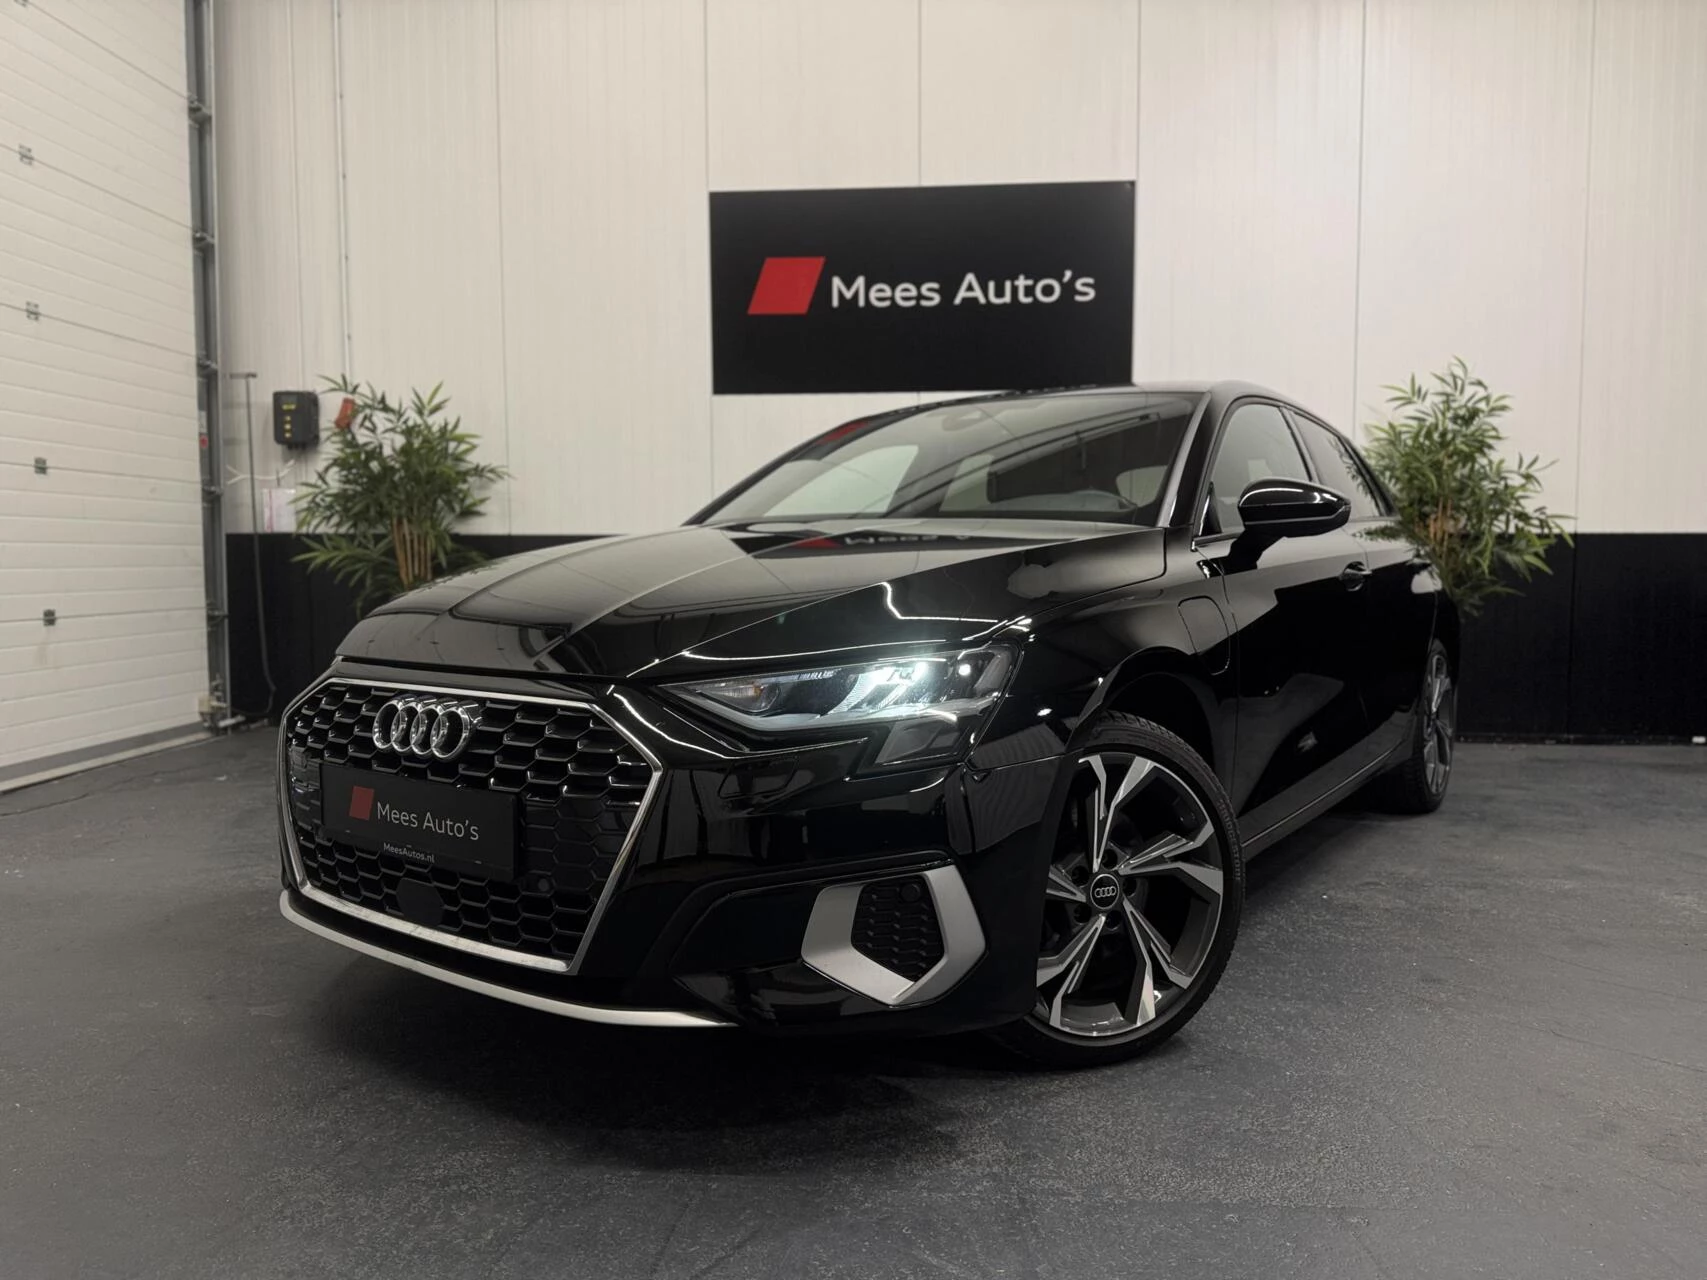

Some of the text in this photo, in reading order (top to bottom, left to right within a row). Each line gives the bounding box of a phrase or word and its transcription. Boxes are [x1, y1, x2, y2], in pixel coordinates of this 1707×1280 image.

[831, 269, 1096, 308] Mees Auto's
[377, 801, 479, 841] Mees Auto's
[383, 842, 435, 863] MeesAutos.nl
